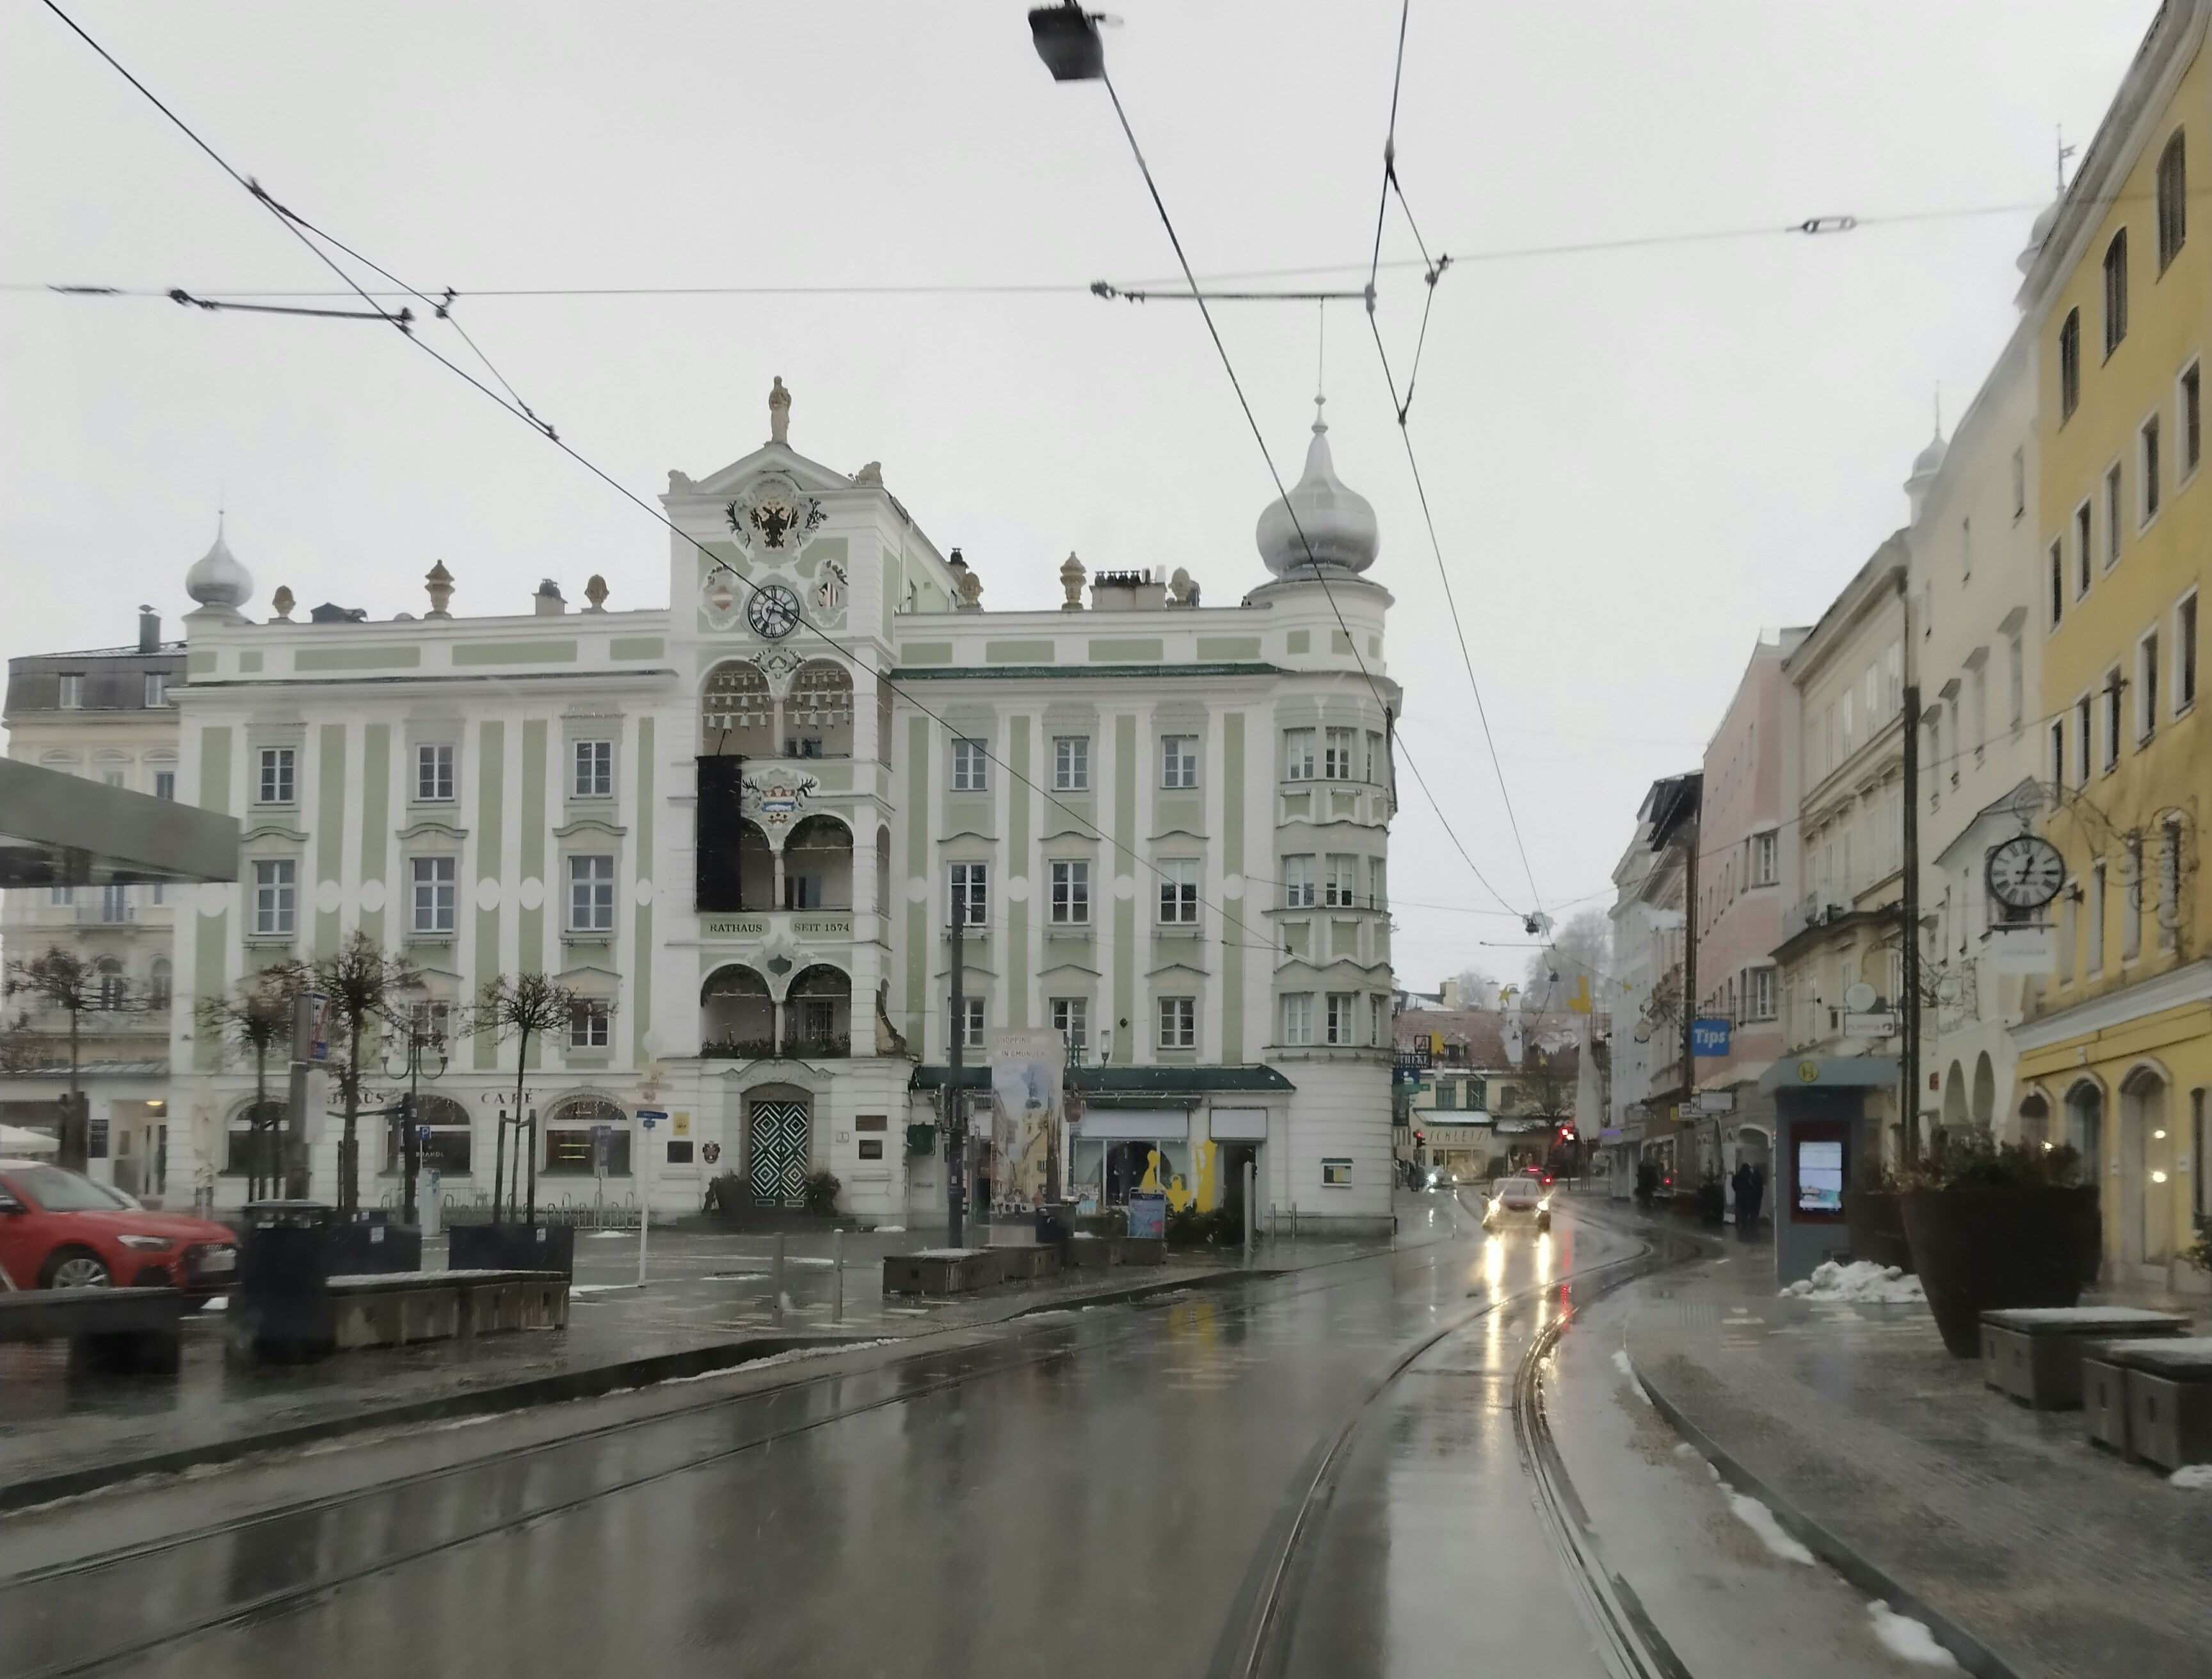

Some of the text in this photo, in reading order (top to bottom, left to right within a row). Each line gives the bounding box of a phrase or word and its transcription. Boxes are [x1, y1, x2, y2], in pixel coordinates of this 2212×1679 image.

[709, 923, 763, 933] RATHAUS
[794, 923, 850, 932] SEIT 1574
[1694, 1028, 1726, 1049] Tips
[422, 1127, 429, 1138] P
[1429, 1130, 1491, 1143] SCHLEISS
